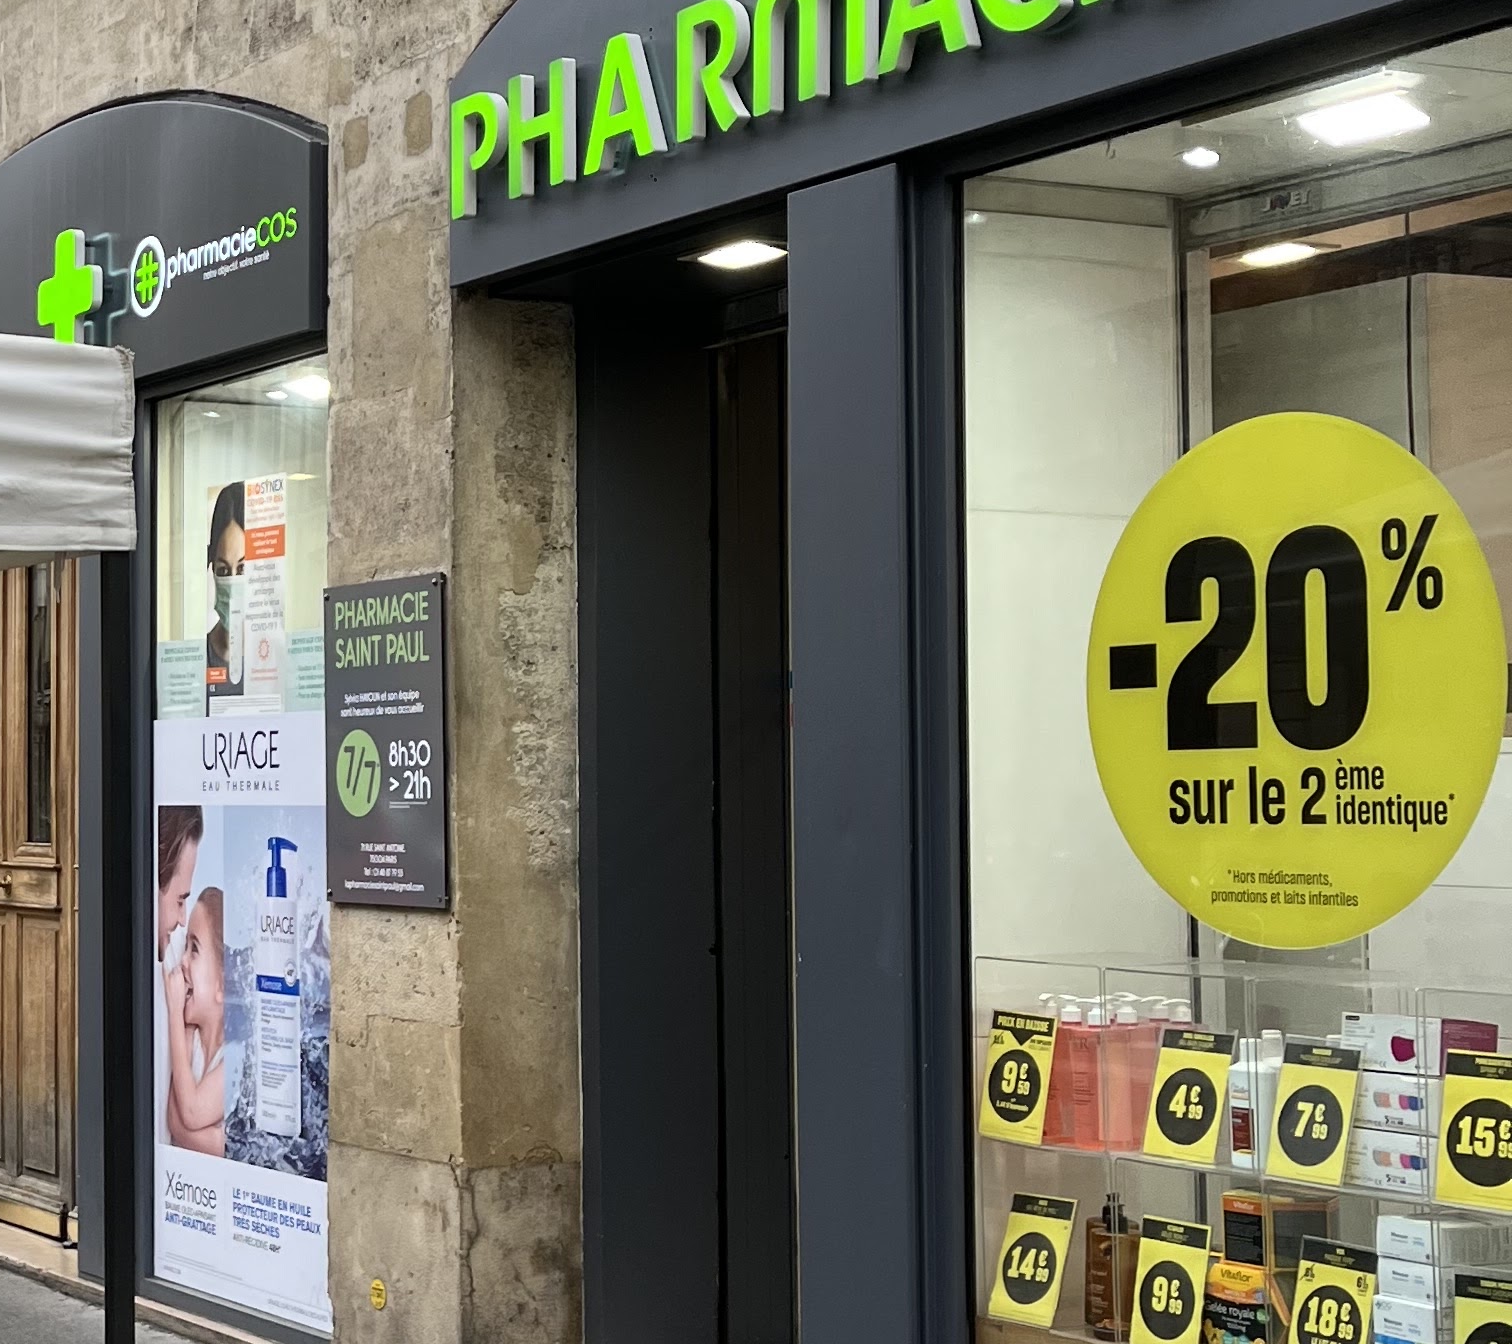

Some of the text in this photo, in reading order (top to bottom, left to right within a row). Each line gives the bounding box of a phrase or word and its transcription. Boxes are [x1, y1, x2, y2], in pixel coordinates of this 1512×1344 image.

[166, 207, 298, 289] pharmacieCOS
[335, 591, 429, 631] PHARMACIE
[335, 635, 381, 669] SAINT
[386, 630, 430, 664] PAUL
[202, 730, 280, 778] URIAGE
[389, 739, 431, 767] 8h30
[202, 780, 280, 791] EAU THERMALE
[403, 769, 431, 799] 21h
[1169, 758, 1385, 825] sur le 2 ème
[1258, 869, 1333, 887] médicaments,
[1211, 888, 1359, 907] promotions et laits infantiles
[260, 915, 294, 937] URIAGE
[165, 1170, 217, 1209] Xémose
[232, 1187, 241, 1200] LE
[251, 1192, 277, 1208] BAUME
[278, 1199, 287, 1212] EN
[289, 1201, 312, 1218] HUILE
[165, 1211, 217, 1235] ANTI-GRATTAGE
[232, 1201, 322, 1235] PROTECTEUR DES PEAUX
[1220, 1268, 1254, 1283] Vitaflor
[1228, 1306, 1256, 1321] royale
